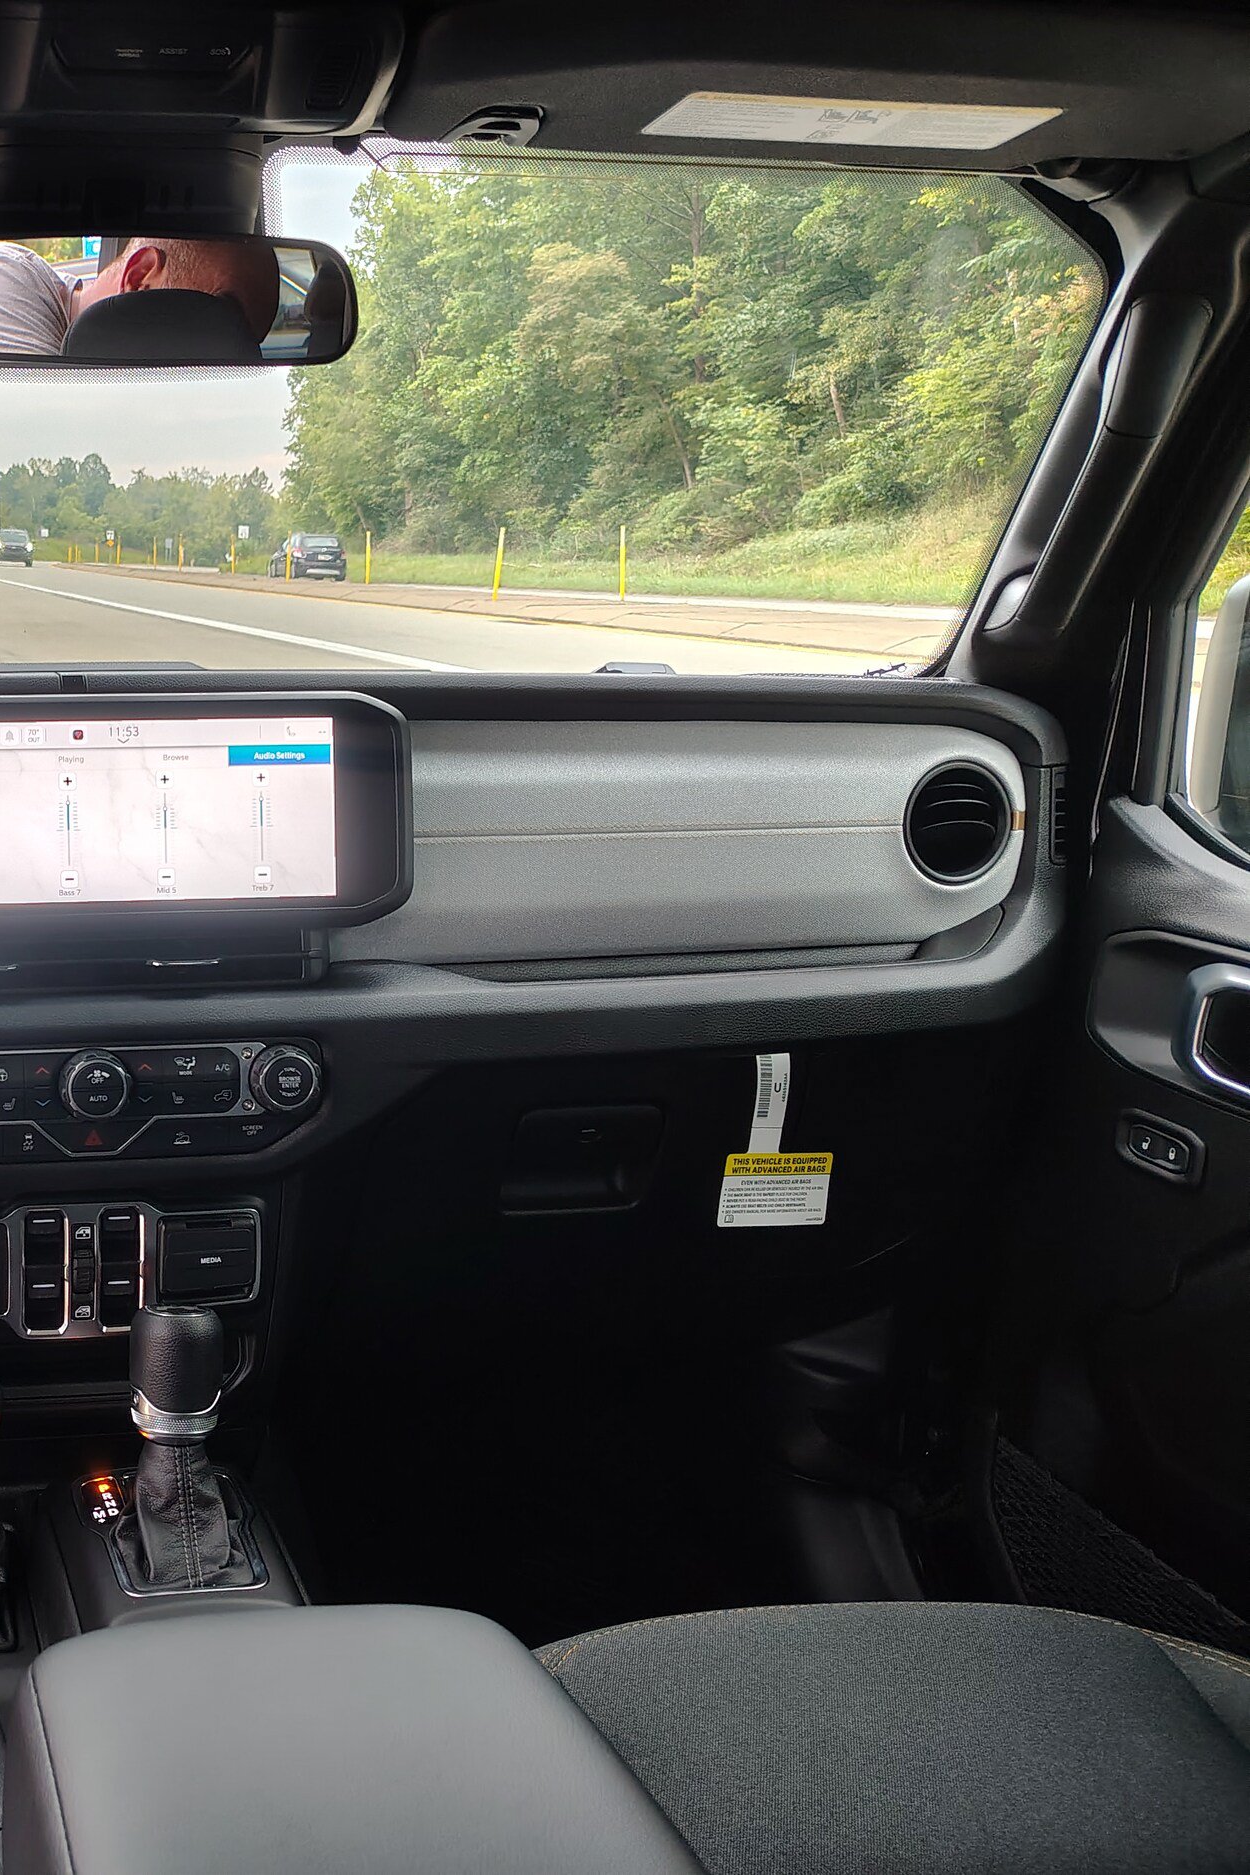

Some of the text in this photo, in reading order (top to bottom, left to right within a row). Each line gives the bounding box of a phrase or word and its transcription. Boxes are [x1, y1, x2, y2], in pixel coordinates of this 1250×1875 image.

[109, 726, 139, 737] 11:53
[58, 755, 84, 764] Playing
[254, 751, 306, 760] Audio Settings
[156, 886, 171, 894] Mid
[215, 1063, 230, 1071] A/C
[774, 1082, 781, 1093] U
[783, 1157, 791, 1165] IS
[200, 1256, 222, 1264] MEDIA
[98, 1484, 110, 1493] P
[101, 1492, 113, 1500] R
[104, 1499, 117, 1508] N
[92, 1509, 107, 1519] M
[107, 1508, 120, 1516] D
